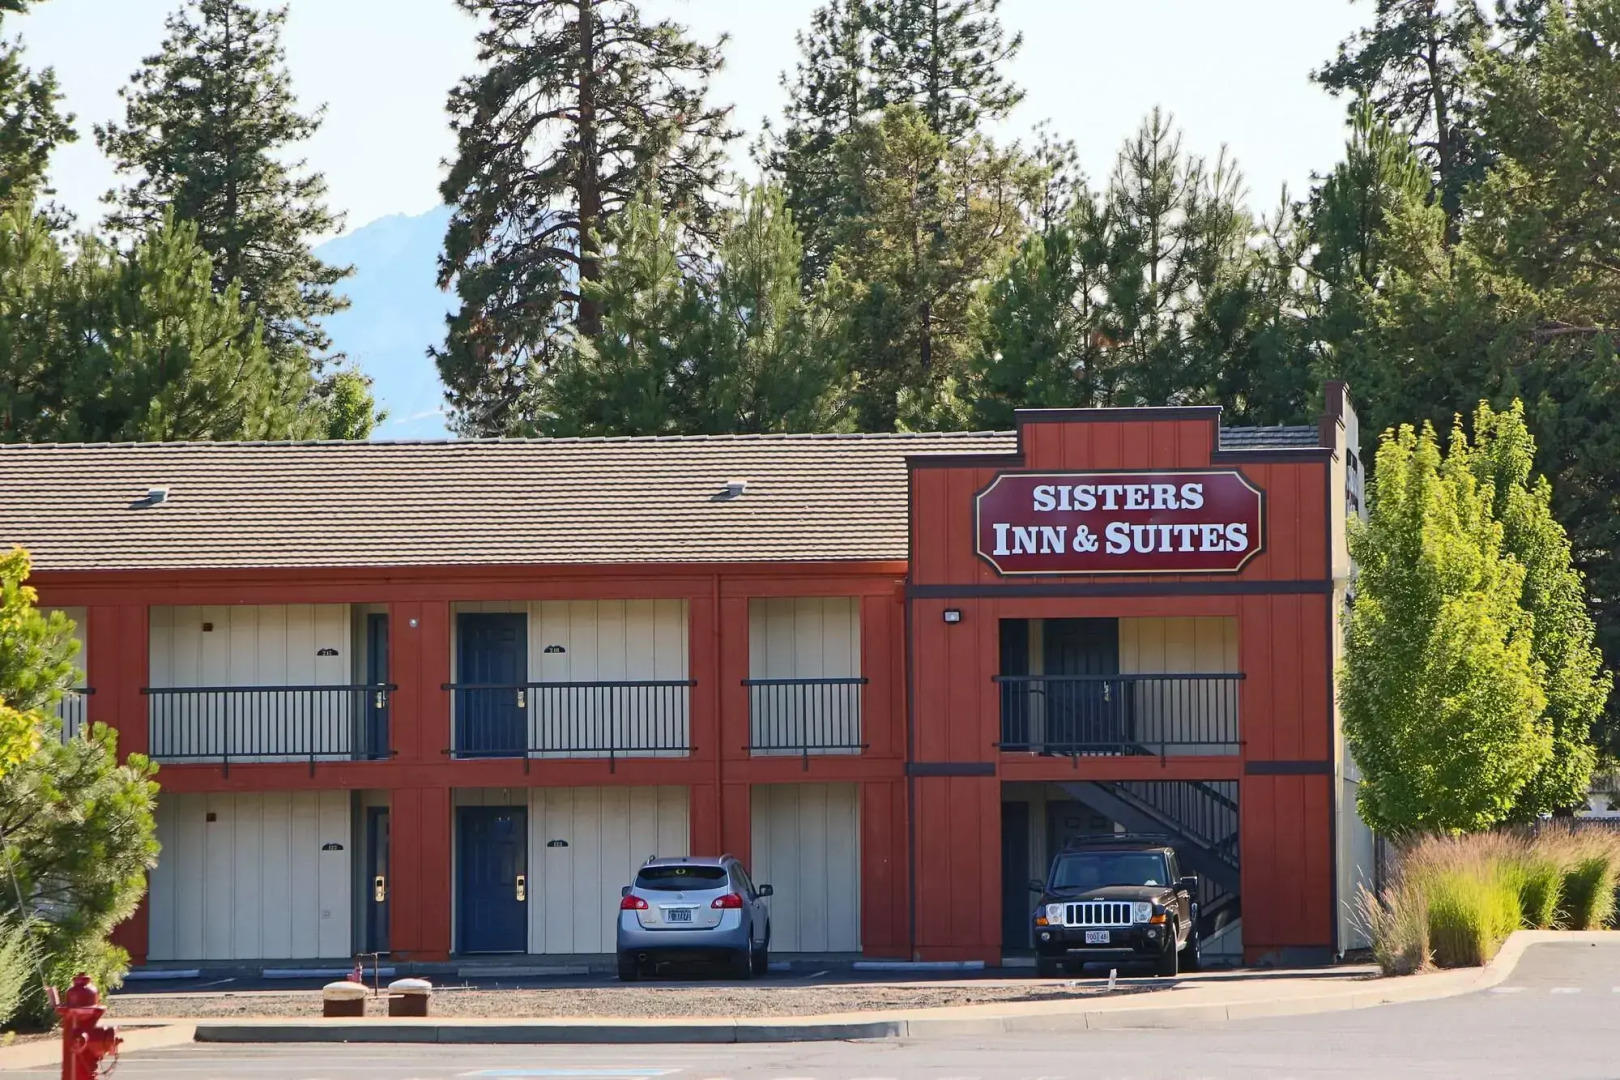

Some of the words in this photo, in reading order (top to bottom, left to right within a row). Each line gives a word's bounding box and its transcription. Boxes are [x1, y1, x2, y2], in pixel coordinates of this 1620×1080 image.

[1033, 483, 1204, 511] SISTERS
[993, 523, 1067, 556] INN
[1072, 525, 1099, 553] &
[1105, 522, 1248, 554] SUITES
